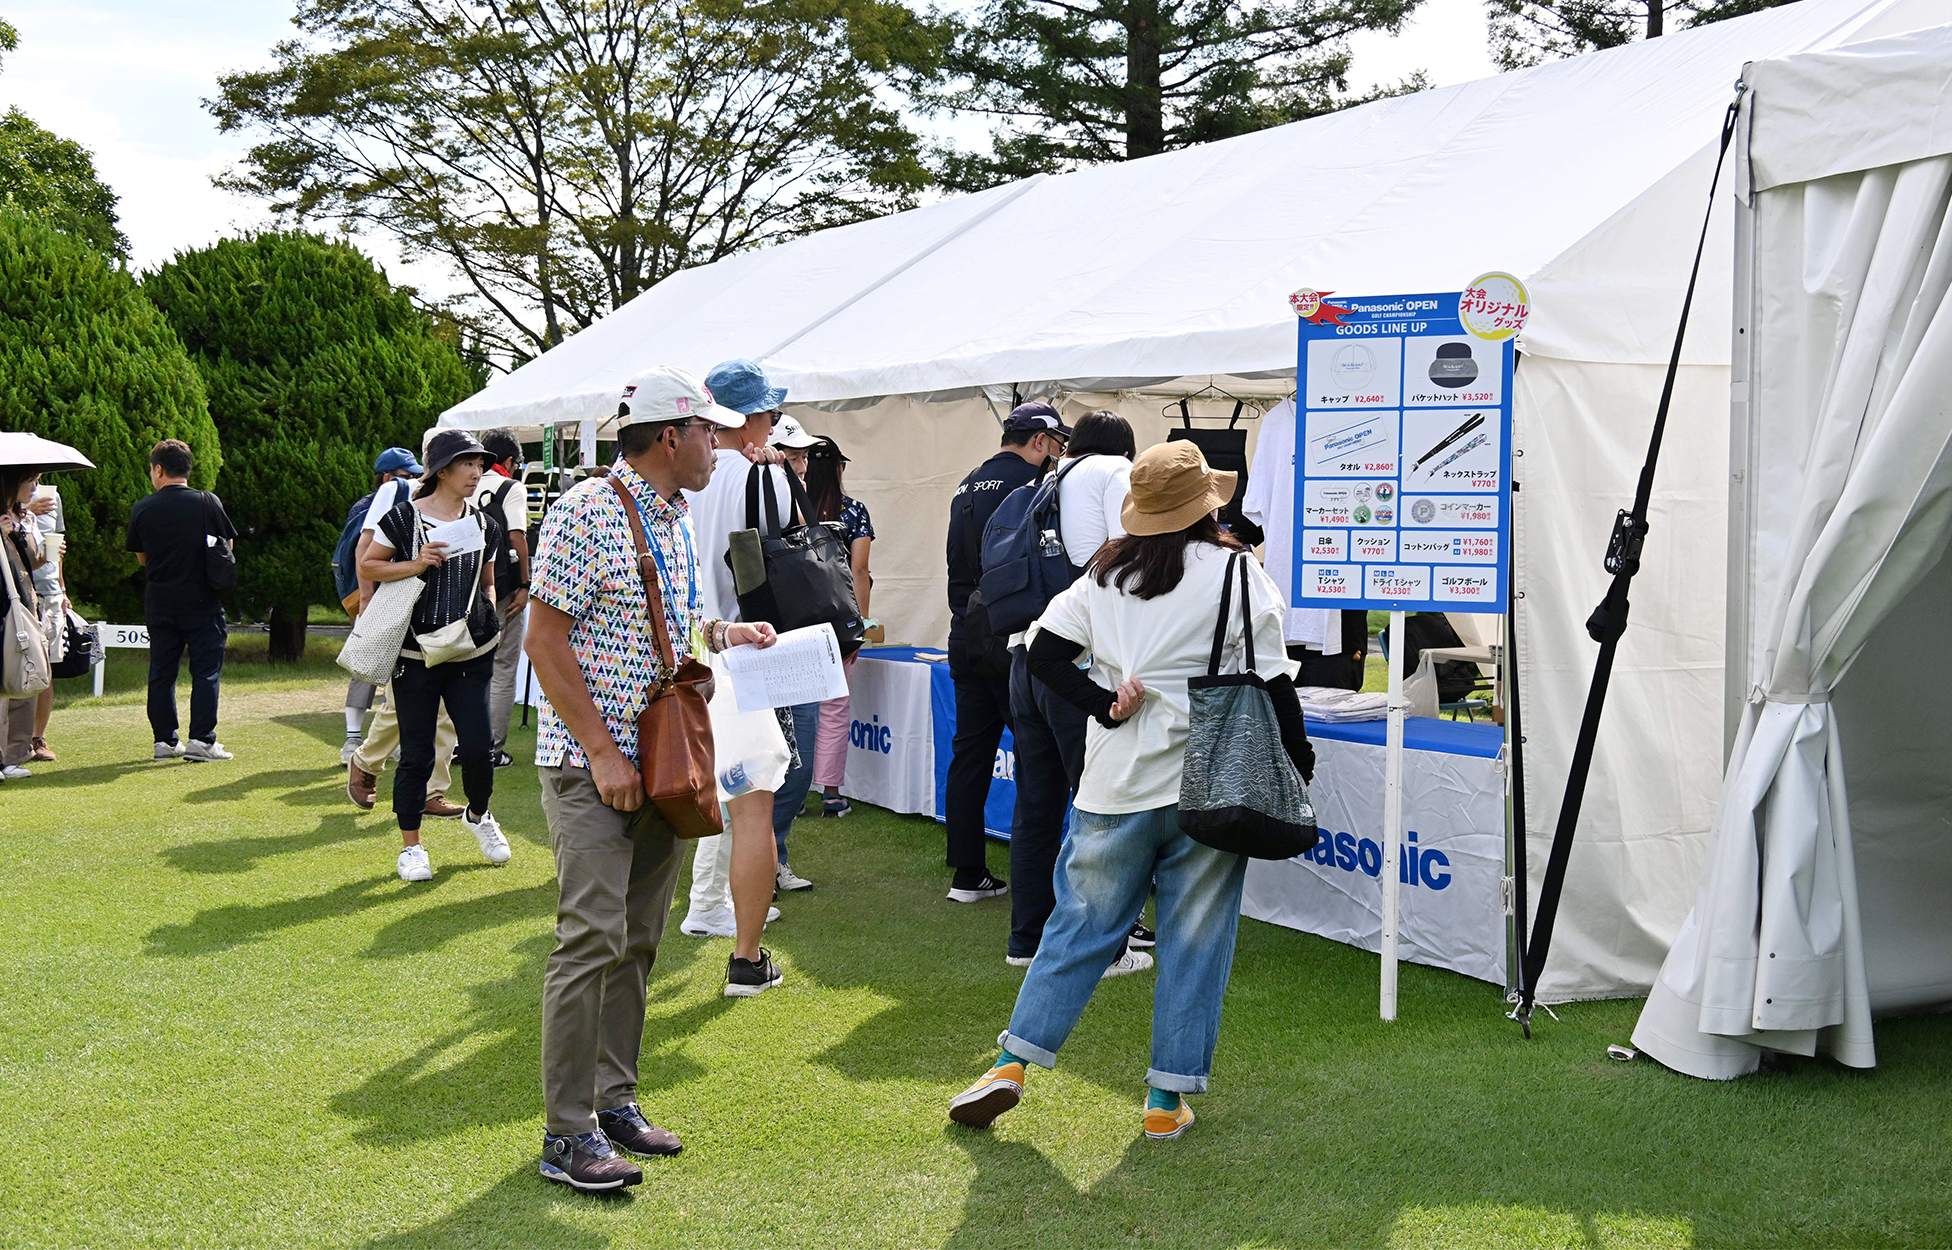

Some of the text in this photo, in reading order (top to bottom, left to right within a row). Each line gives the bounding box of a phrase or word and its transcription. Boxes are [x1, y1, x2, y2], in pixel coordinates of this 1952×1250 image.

[1290, 292, 1318, 303] 本大会
[1466, 288, 1486, 299] 大会
[1351, 300, 1438, 313] Panasonic OPEN
[1460, 299, 1528, 318] オリジナル
[1336, 322, 1427, 335] GOODS LINE UP
[1494, 317, 1524, 329] グッズ
[1321, 395, 1349, 403] キャップ
[1443, 470, 1497, 478] ネックストラップ
[973, 480, 1004, 492] SPORT
[1442, 578, 1488, 586] ゴルフボール
[848, 715, 891, 754] onic
